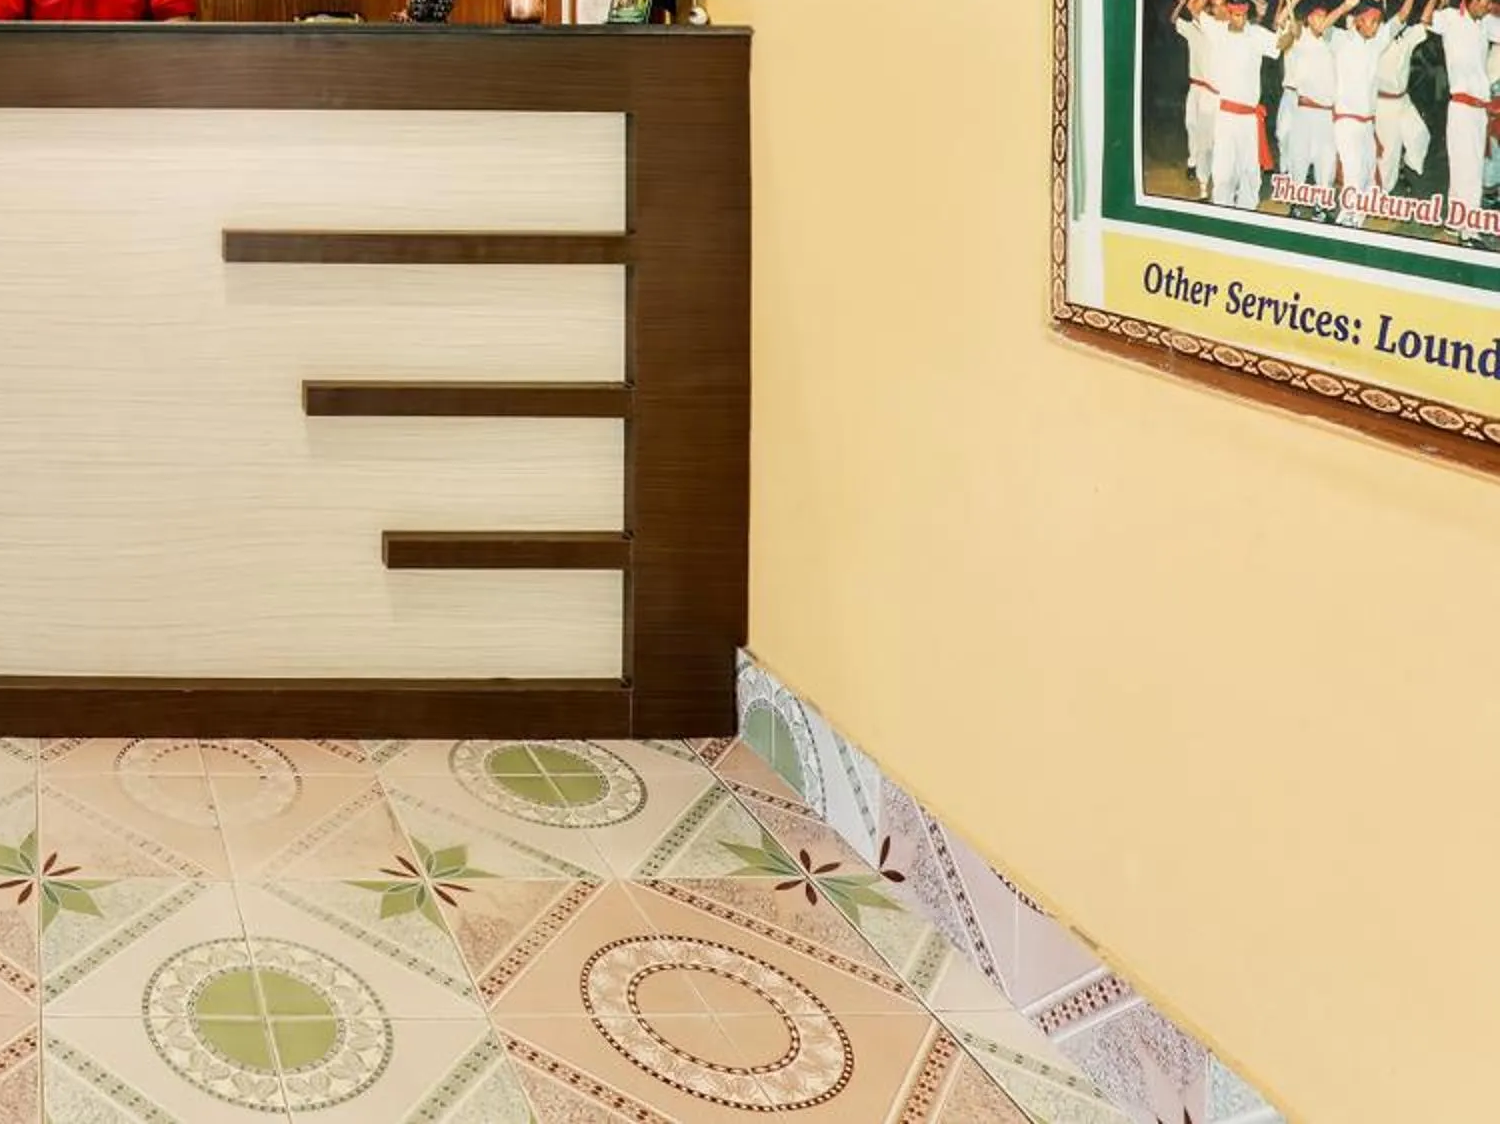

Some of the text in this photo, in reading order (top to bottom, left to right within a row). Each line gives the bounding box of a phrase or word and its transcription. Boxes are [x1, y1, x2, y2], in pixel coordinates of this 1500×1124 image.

[1273, 175, 1335, 209] Tharu
[1340, 184, 1442, 226] Cultural
[1143, 262, 1500, 381] Other Services: Lound
